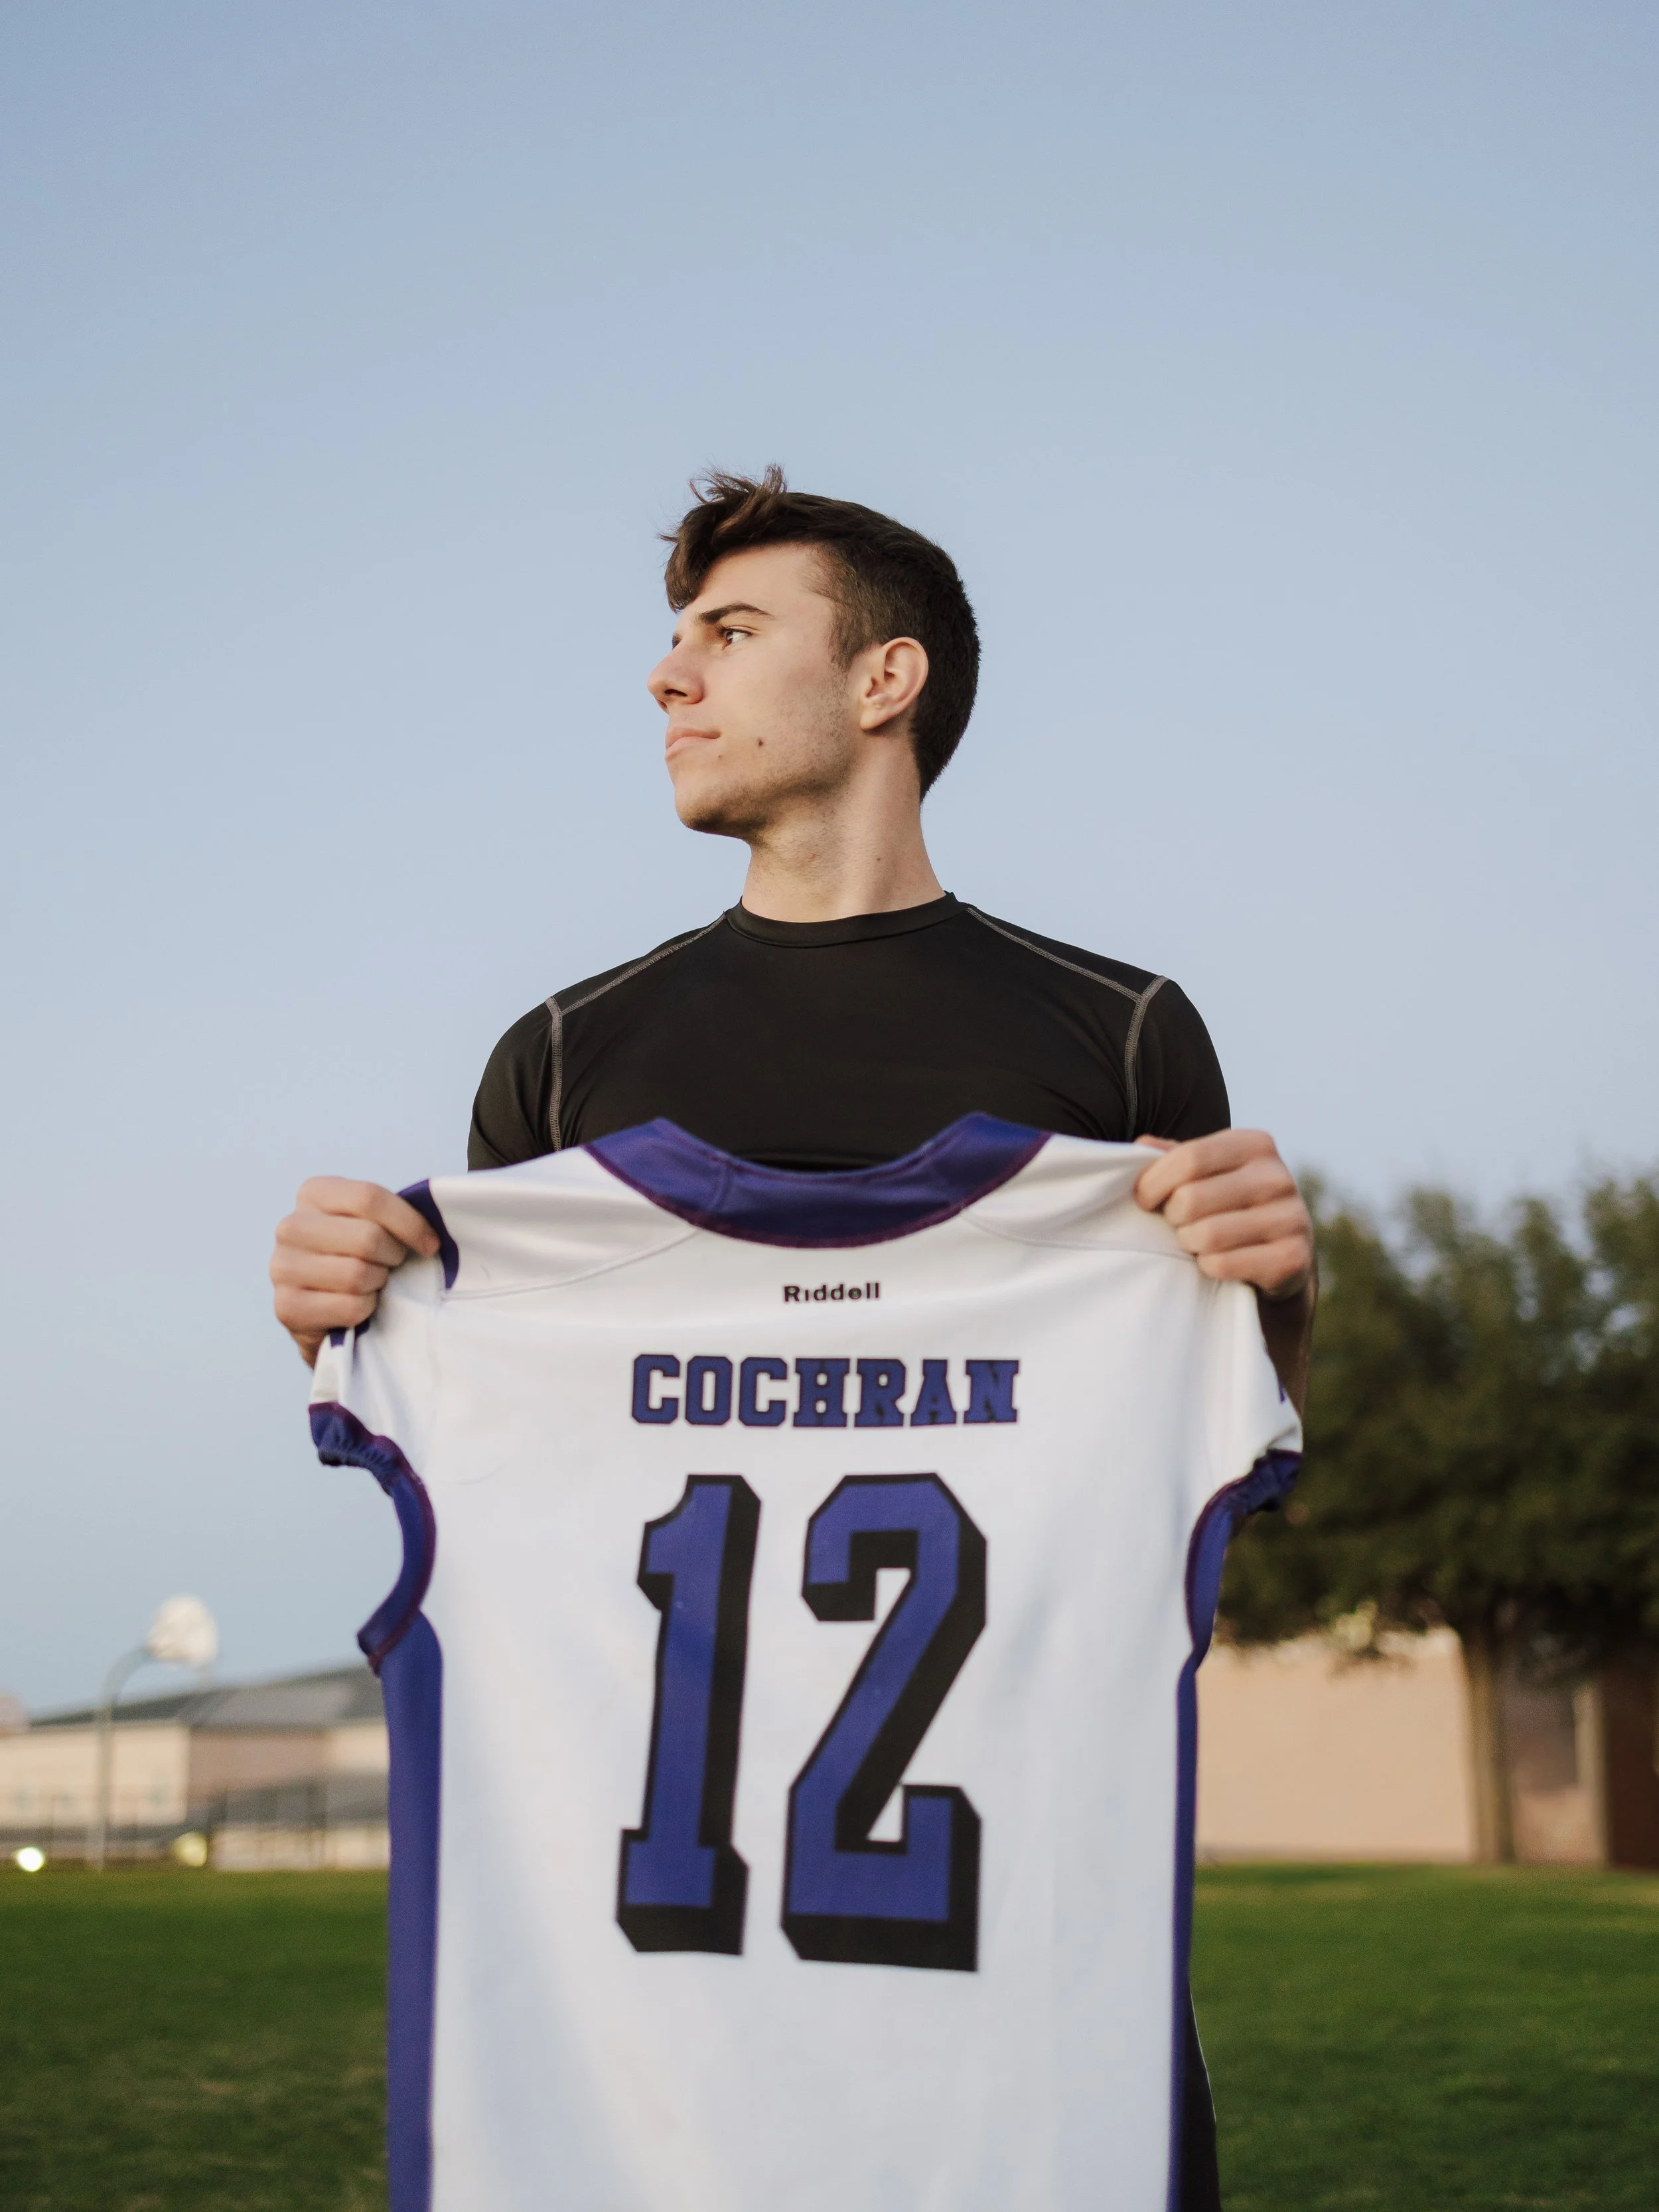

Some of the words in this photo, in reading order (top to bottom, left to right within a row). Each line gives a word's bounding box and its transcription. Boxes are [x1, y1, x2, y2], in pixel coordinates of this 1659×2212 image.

[784, 1282, 880, 1302] Riddell
[632, 1354, 1020, 1428] COCHRAN
[615, 1472, 987, 1972] 12
